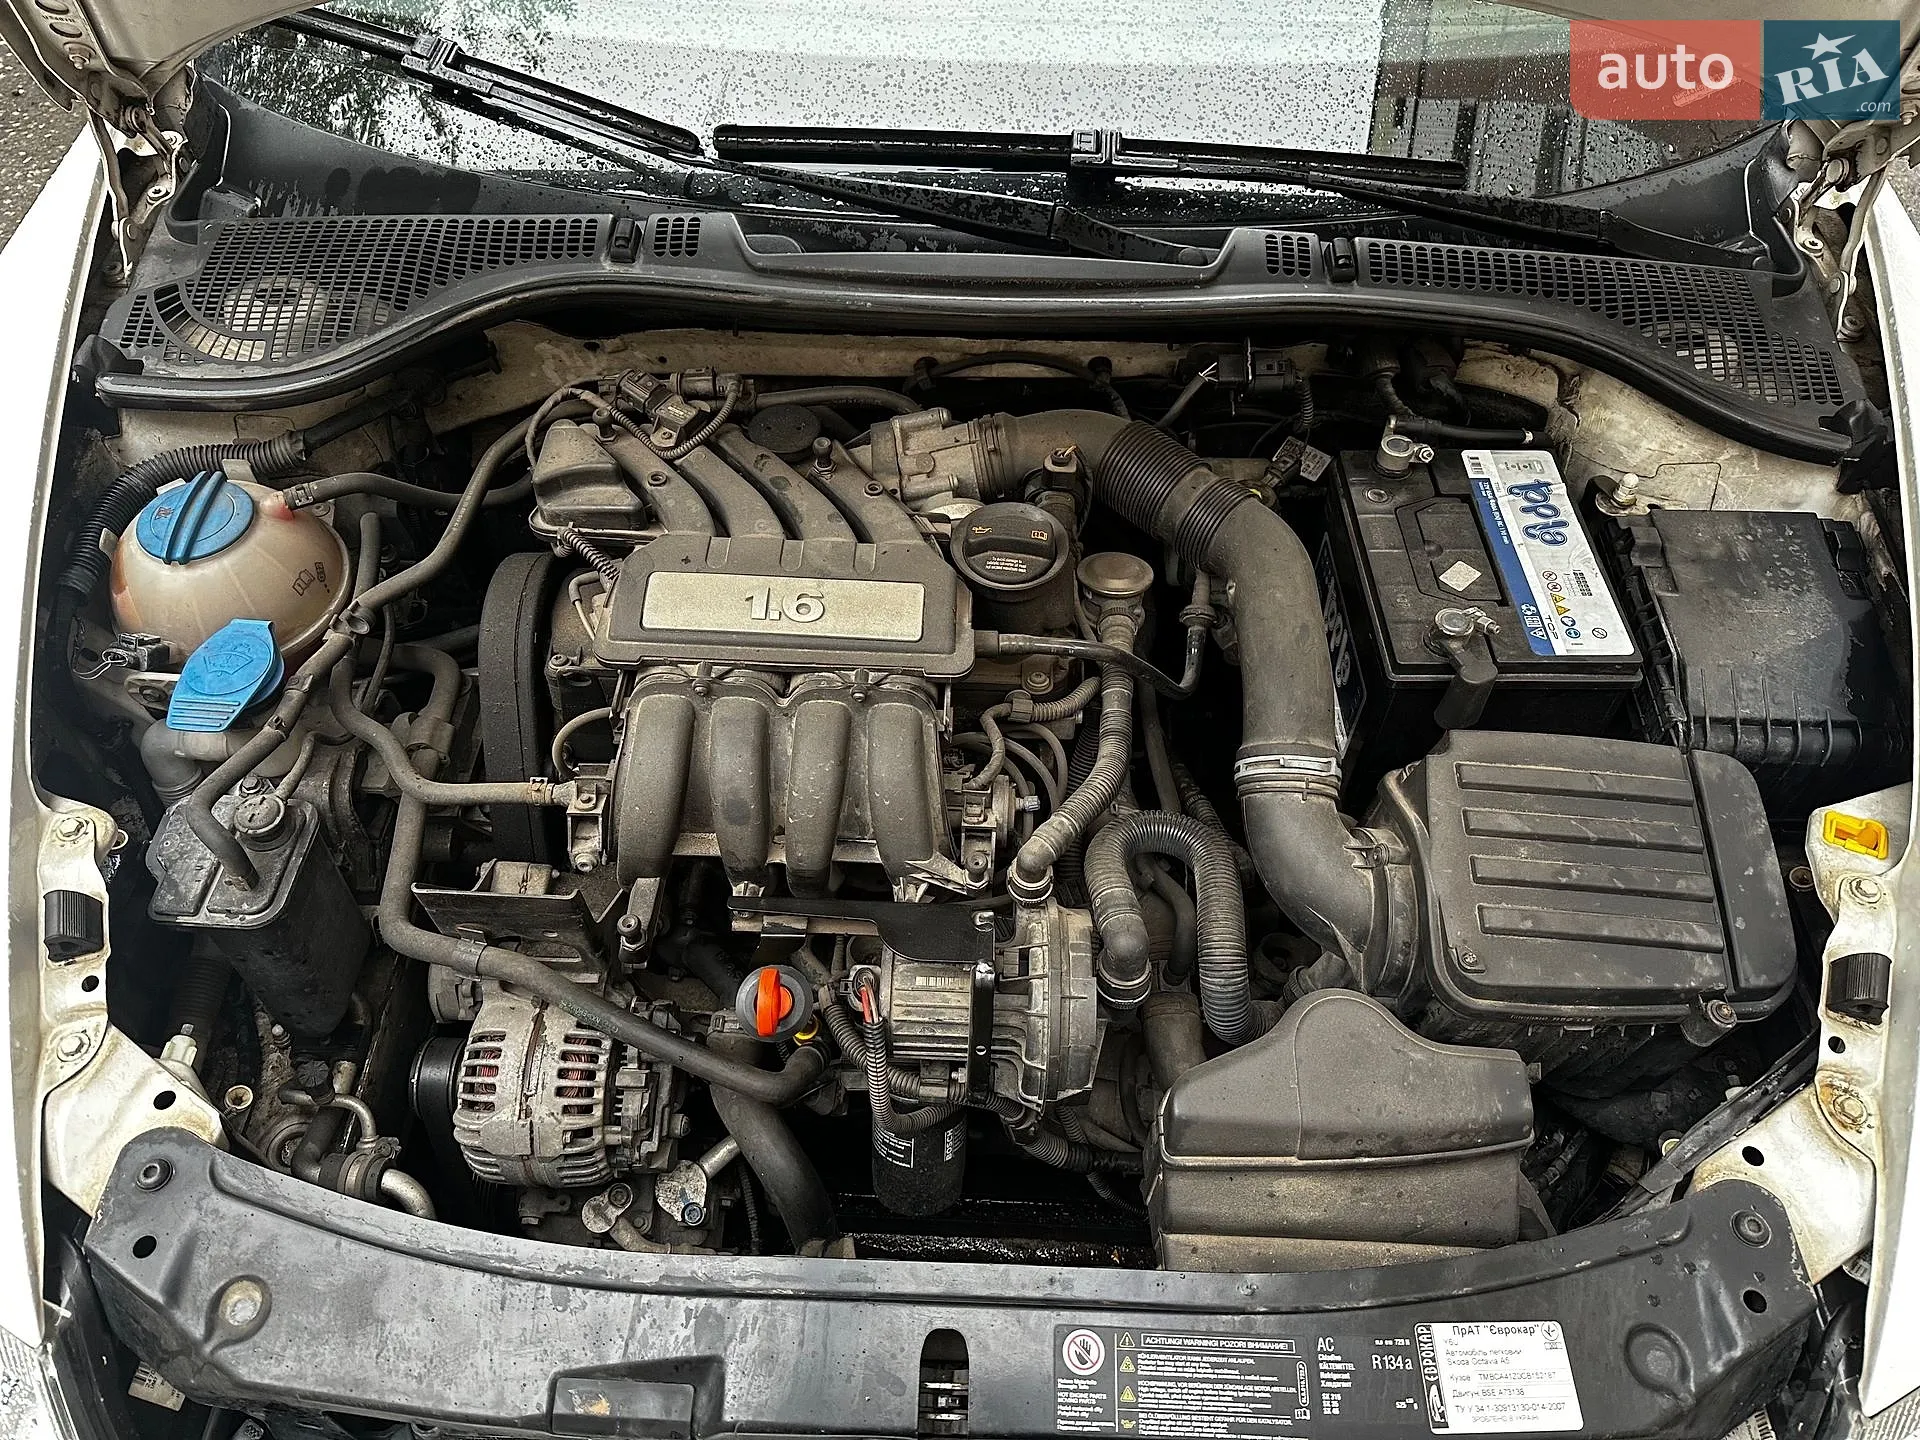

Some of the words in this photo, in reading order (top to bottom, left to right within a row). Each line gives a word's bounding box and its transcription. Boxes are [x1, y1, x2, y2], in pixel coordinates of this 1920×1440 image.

[744, 586, 825, 623] 1.6
[1452, 1325, 1480, 1337] ПрАТ
[1484, 1324, 1539, 1336] "Єврокар"
[1317, 1337, 1335, 1351] AC
[1418, 1326, 1439, 1381] ЄВРОКАР
